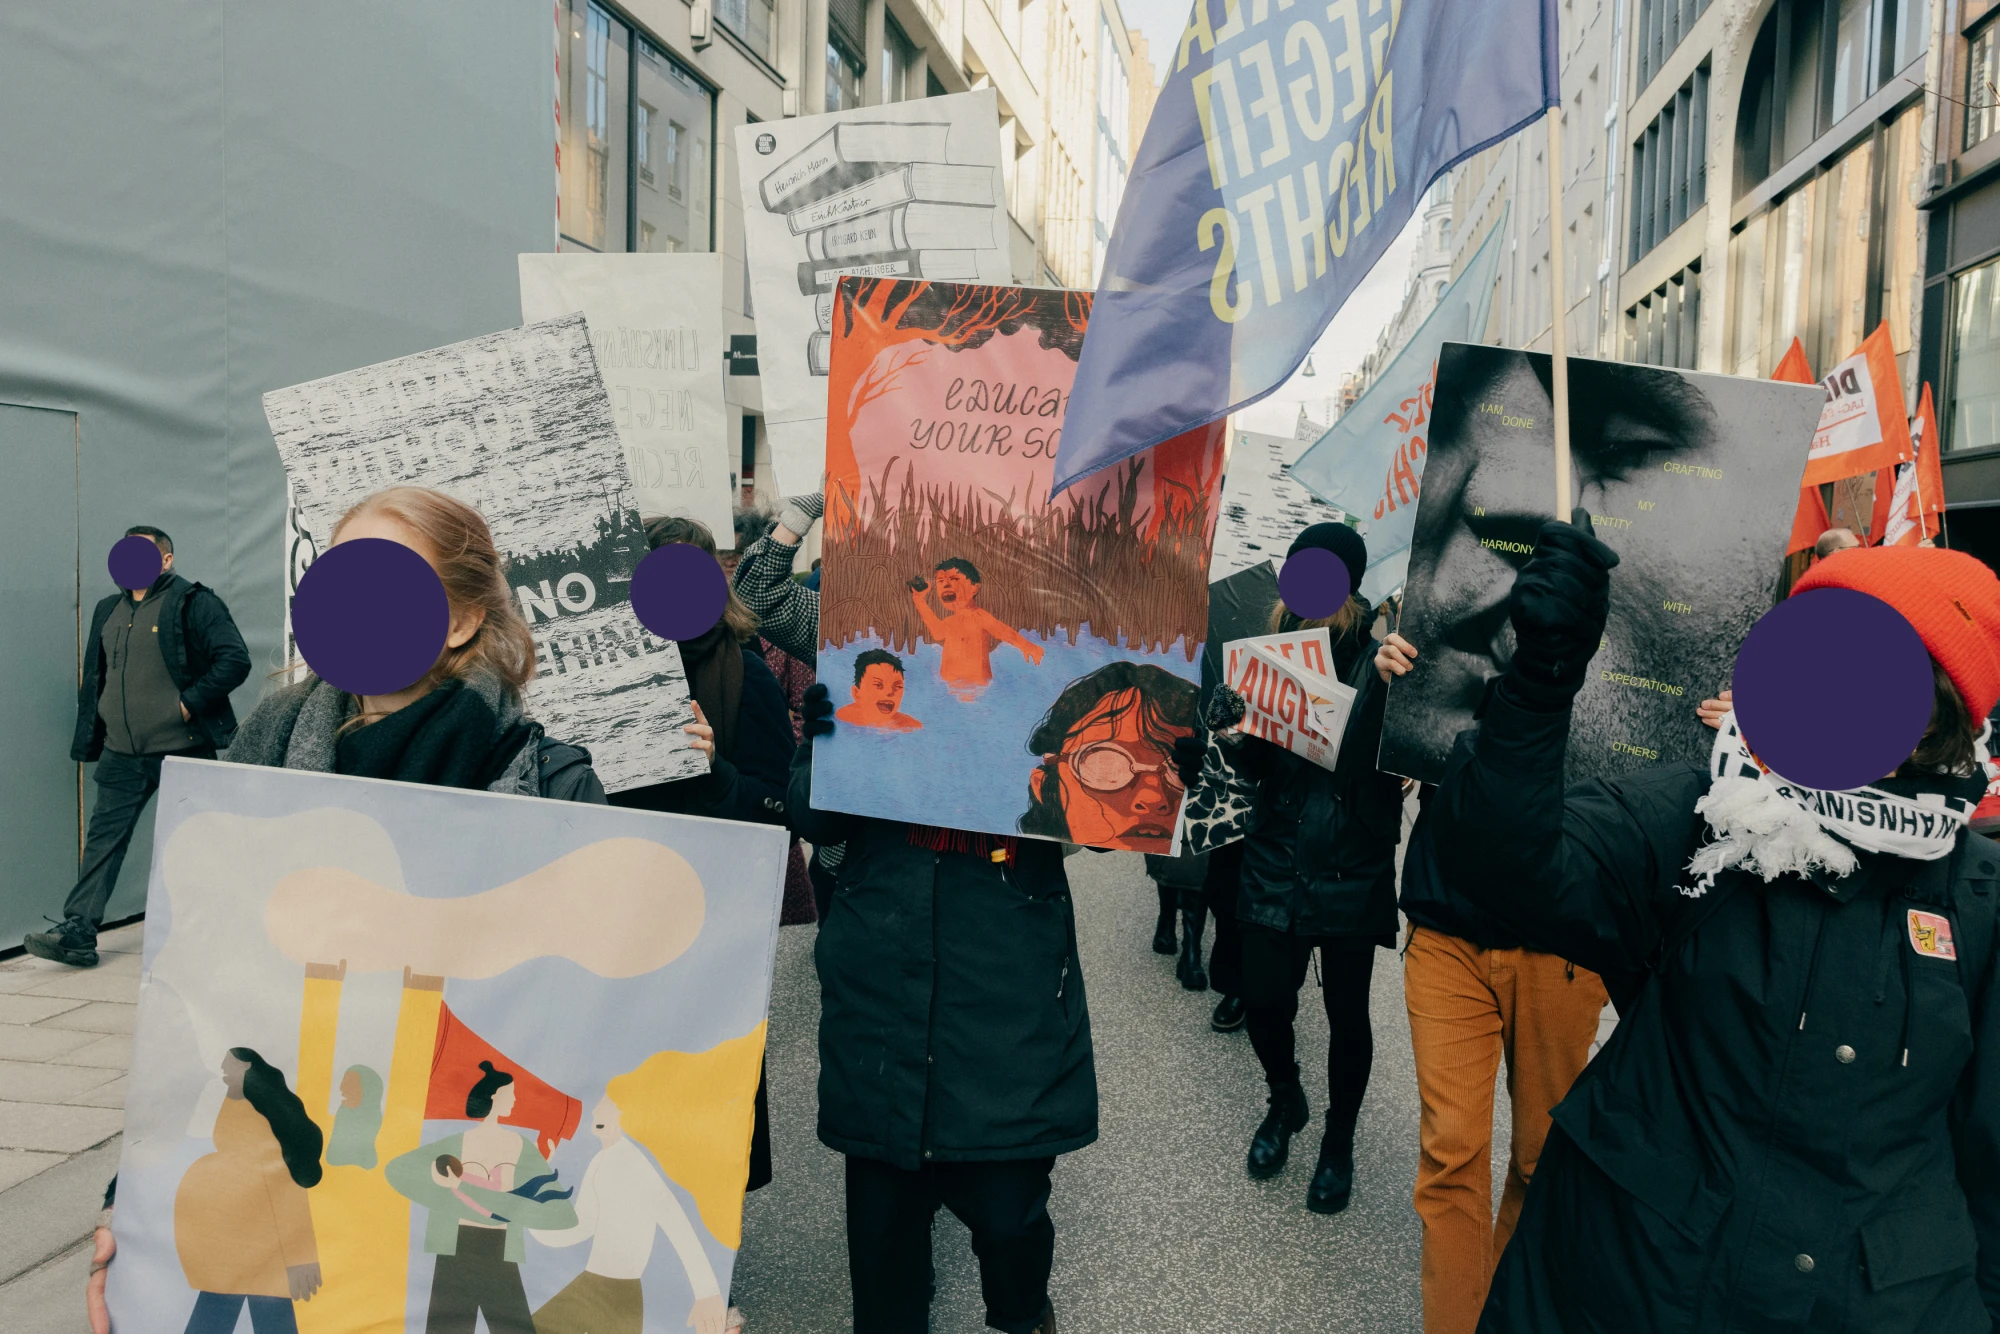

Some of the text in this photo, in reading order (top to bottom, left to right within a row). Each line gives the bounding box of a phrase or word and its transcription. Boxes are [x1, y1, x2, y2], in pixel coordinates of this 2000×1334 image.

[1480, 403, 1504, 415] I AM
[1501, 415, 1535, 429] DONE
[910, 417, 1013, 457] YOUR
[1663, 460, 1723, 481] CRAFTING
[1474, 506, 1486, 517] IN
[1637, 499, 1656, 513] MY
[1480, 538, 1535, 555] HARMONY
[516, 573, 594, 624] NO
[1663, 600, 1692, 615] WITH
[1601, 670, 1684, 697] EXPECTATIONS
[1237, 655, 1329, 746] AUGE
[1612, 741, 1658, 760] OTHERS
